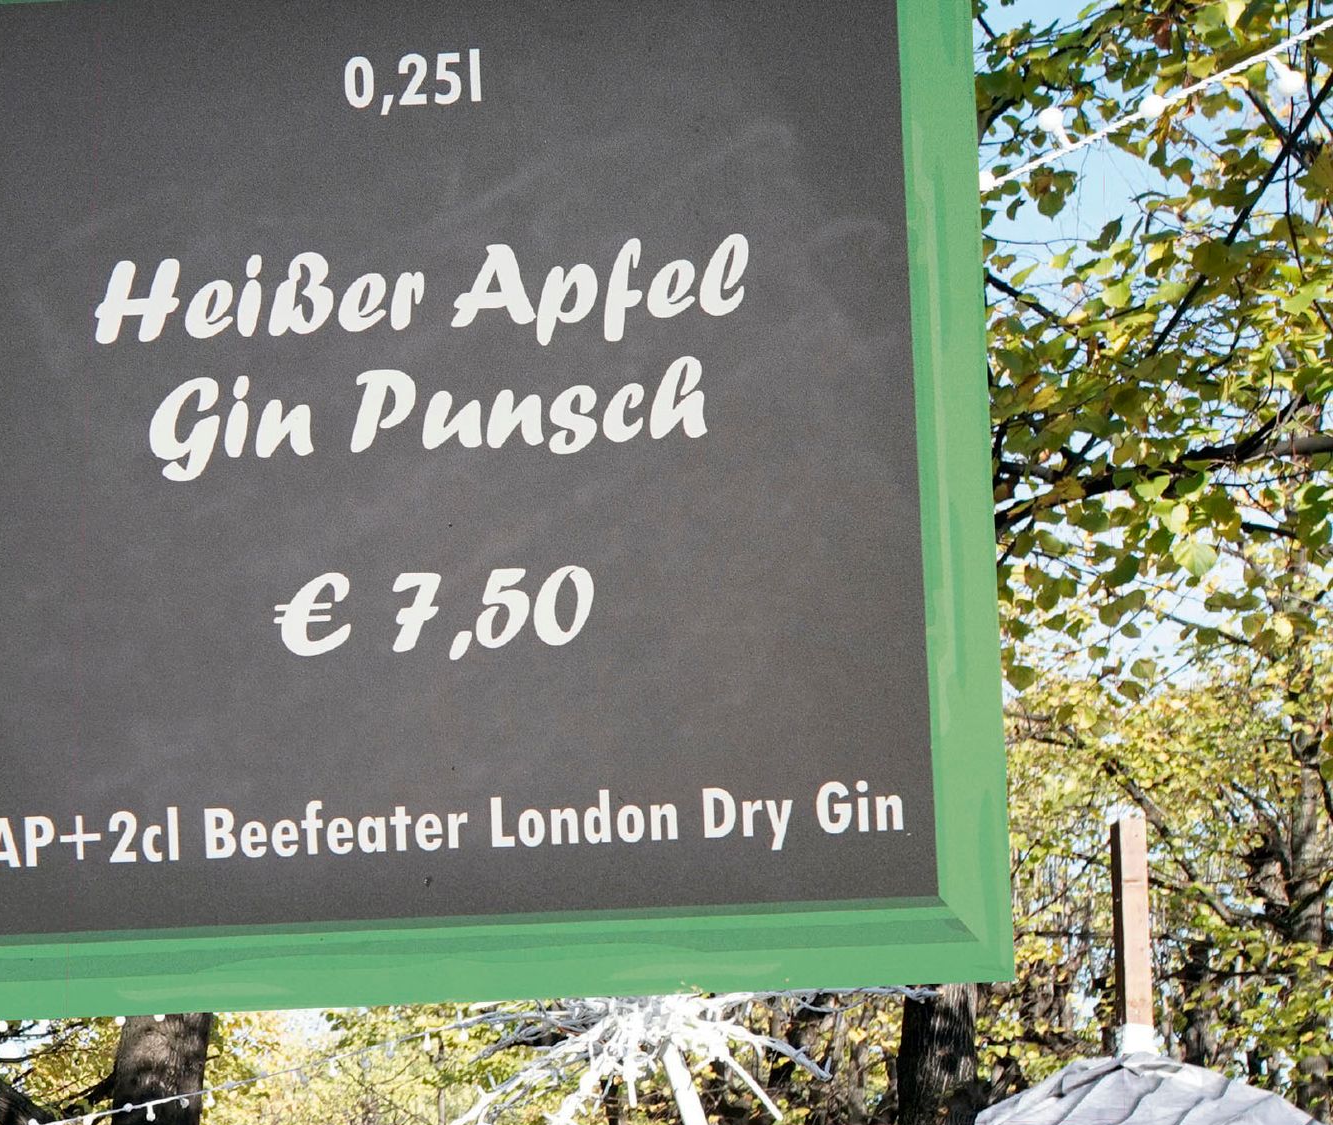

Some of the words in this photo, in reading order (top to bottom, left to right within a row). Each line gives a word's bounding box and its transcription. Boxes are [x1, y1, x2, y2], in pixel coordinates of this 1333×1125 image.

[344, 48, 482, 116] 0,25l
[94, 251, 425, 345] Heißer
[450, 233, 750, 347] Apfel
[148, 375, 315, 482] Gin
[349, 355, 708, 455] Punsch
[273, 572, 352, 657] €
[391, 564, 595, 661] 7,50
[203, 800, 469, 860] Beefeater
[490, 788, 679, 848] London
[701, 787, 794, 851] Dry
[815, 779, 904, 834] Gin
